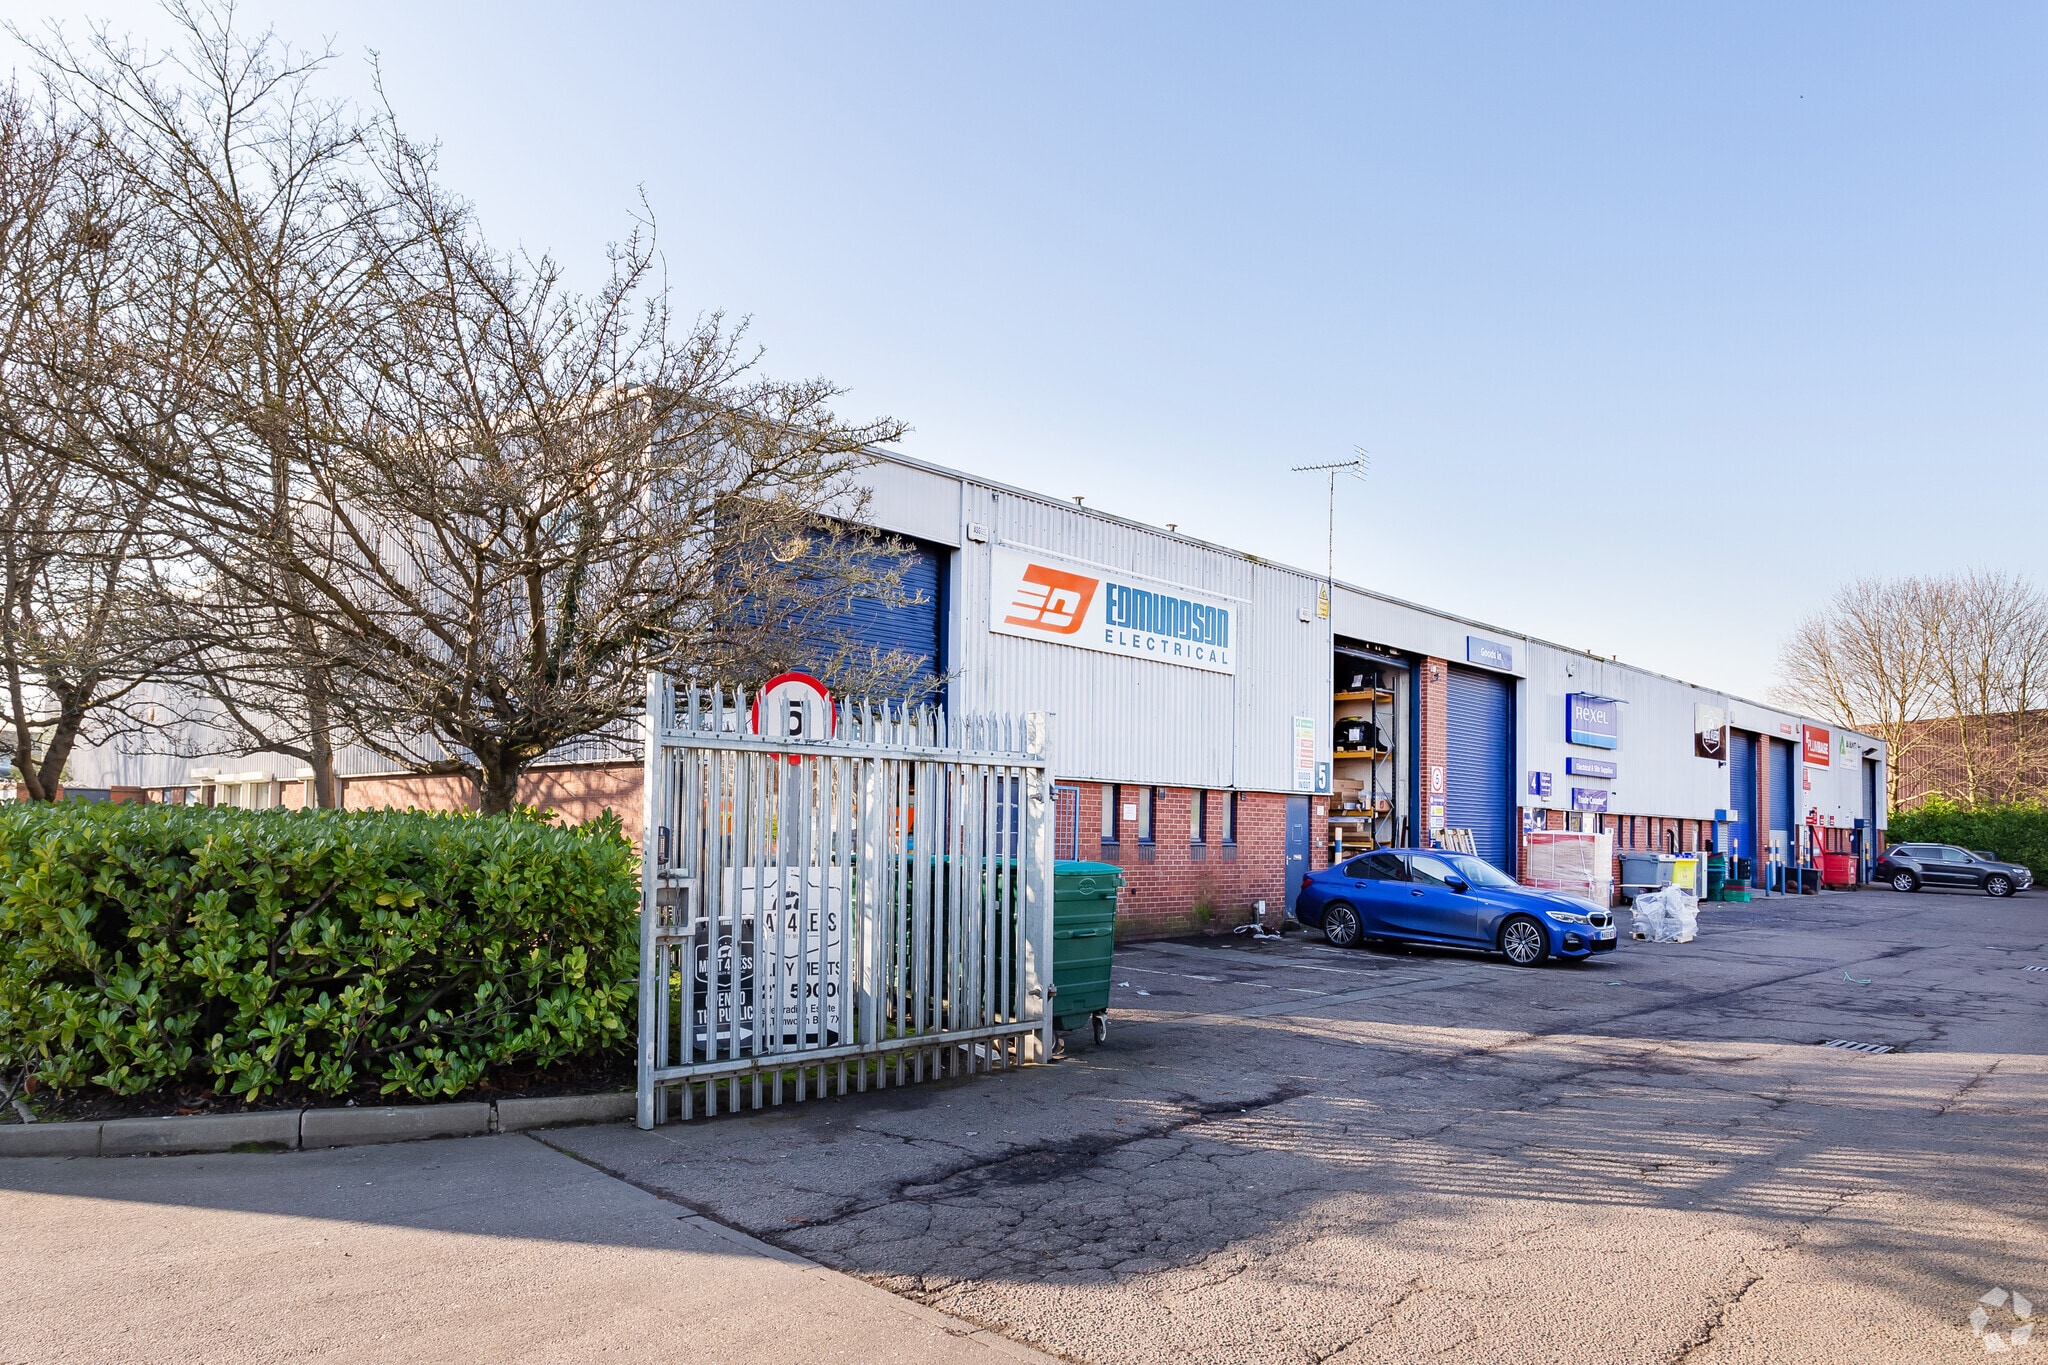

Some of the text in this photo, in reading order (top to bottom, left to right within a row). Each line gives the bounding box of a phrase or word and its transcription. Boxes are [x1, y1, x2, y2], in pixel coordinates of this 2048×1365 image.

[1106, 582, 1228, 648] EDMUNDSON
[1105, 629, 1228, 665] ELECTRICAL
[1481, 647, 1497, 659] Goods
[1318, 764, 1326, 790] 5
[1435, 773, 1440, 785] 5
[1531, 776, 1537, 790] 4
[787, 912, 797, 932] 4
[802, 912, 837, 932] ES
[698, 958, 723, 973] MT
[724, 958, 731, 971] 4
[789, 981, 847, 999] 5900
[705, 992, 731, 1007] EN
[718, 1006, 754, 1023] PULIC
